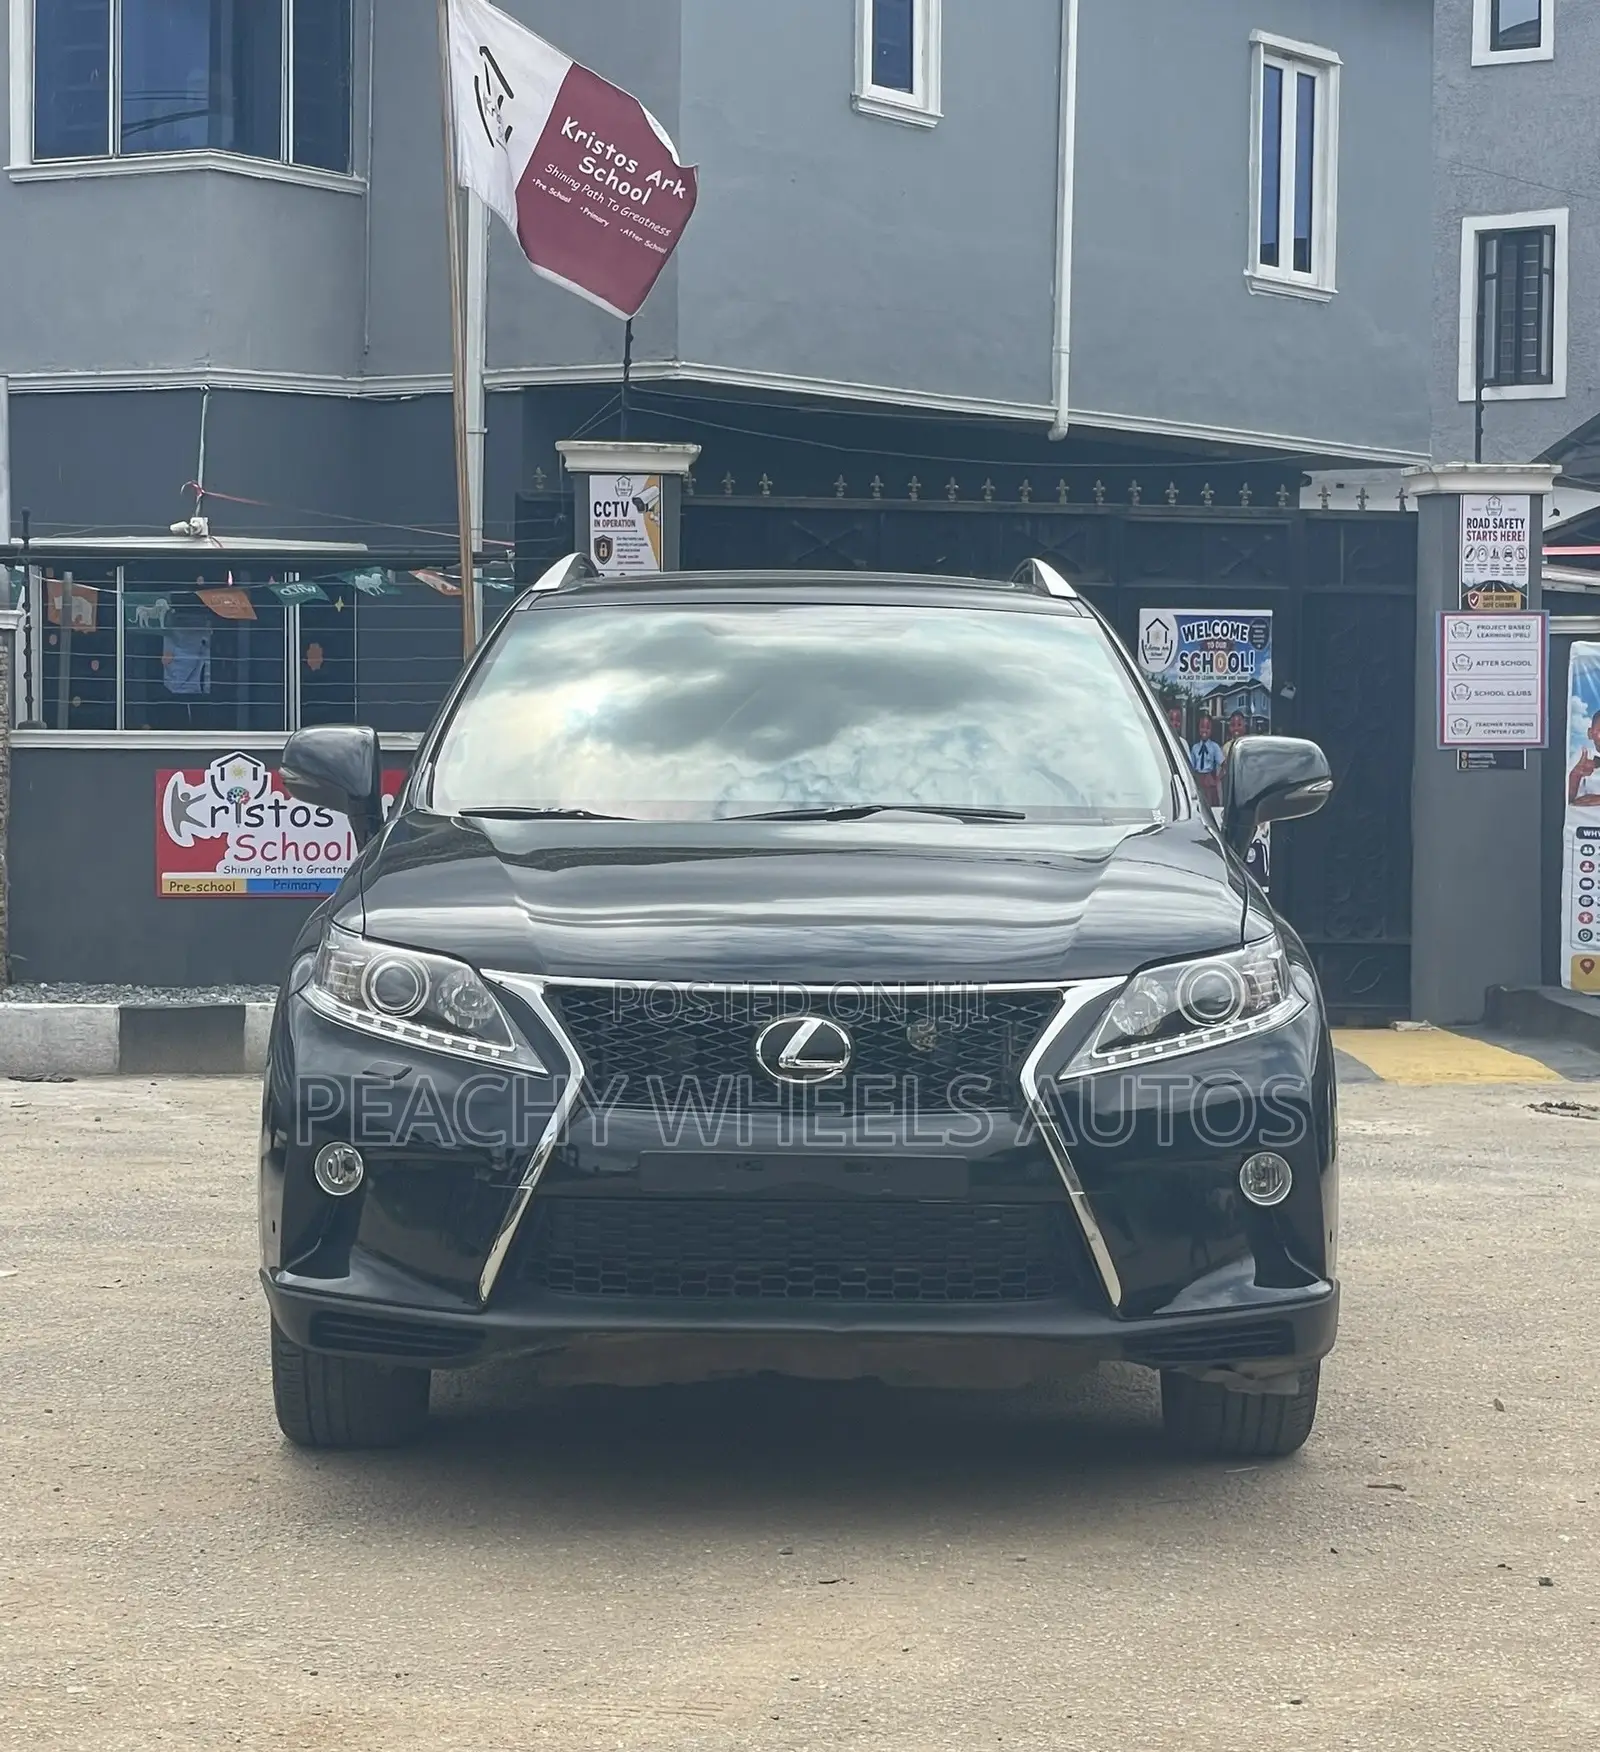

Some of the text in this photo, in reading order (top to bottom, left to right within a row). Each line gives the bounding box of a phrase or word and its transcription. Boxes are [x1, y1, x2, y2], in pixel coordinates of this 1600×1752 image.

[561, 116, 686, 199] Kristos Ark
[578, 156, 652, 205] School
[544, 164, 671, 237] Shining Path To Greatness
[548, 188, 572, 203] School
[644, 240, 667, 254] School
[594, 501, 629, 517] CCTV
[1466, 518, 1525, 529] ROAD SAFETY
[1466, 530, 1525, 541] STARTS HERE!
[1182, 620, 1249, 642] WELCOME
[1180, 650, 1255, 673] SCHOOL!
[234, 831, 352, 862] School
[224, 865, 262, 876] Shining
[264, 865, 290, 874] Path
[293, 866, 303, 874] to
[169, 880, 322, 892] Pre-school Primary
